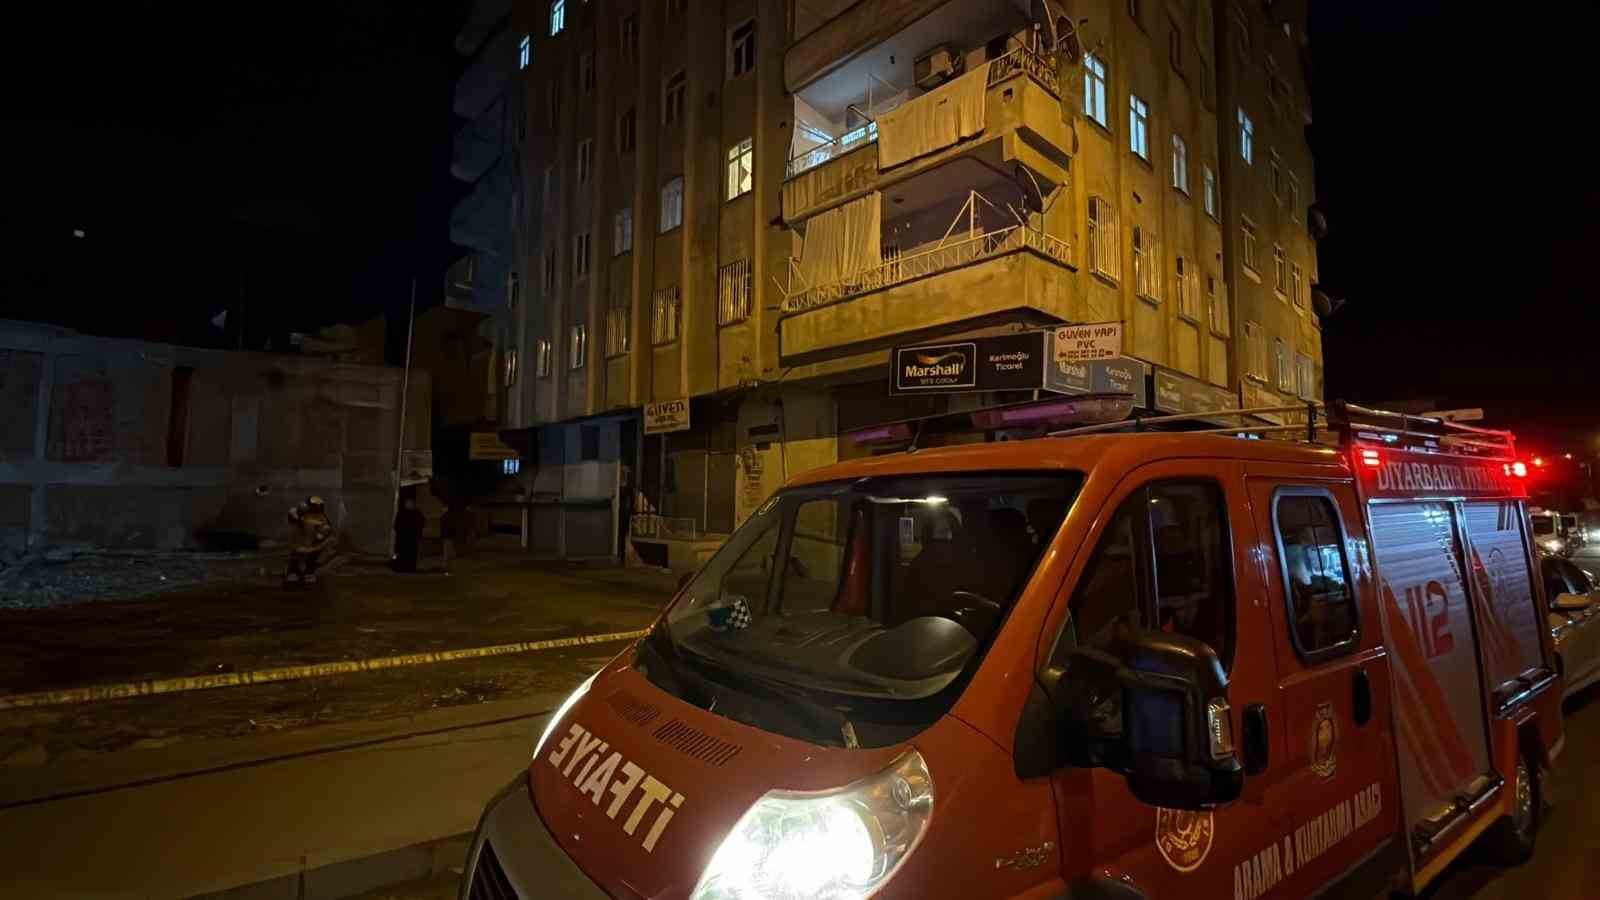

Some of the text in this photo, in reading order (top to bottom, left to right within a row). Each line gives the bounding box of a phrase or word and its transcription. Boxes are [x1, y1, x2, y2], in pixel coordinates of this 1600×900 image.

[1076, 340, 1096, 349] PVC
[905, 363, 960, 378] Marshall
[1284, 835, 1294, 876] &
